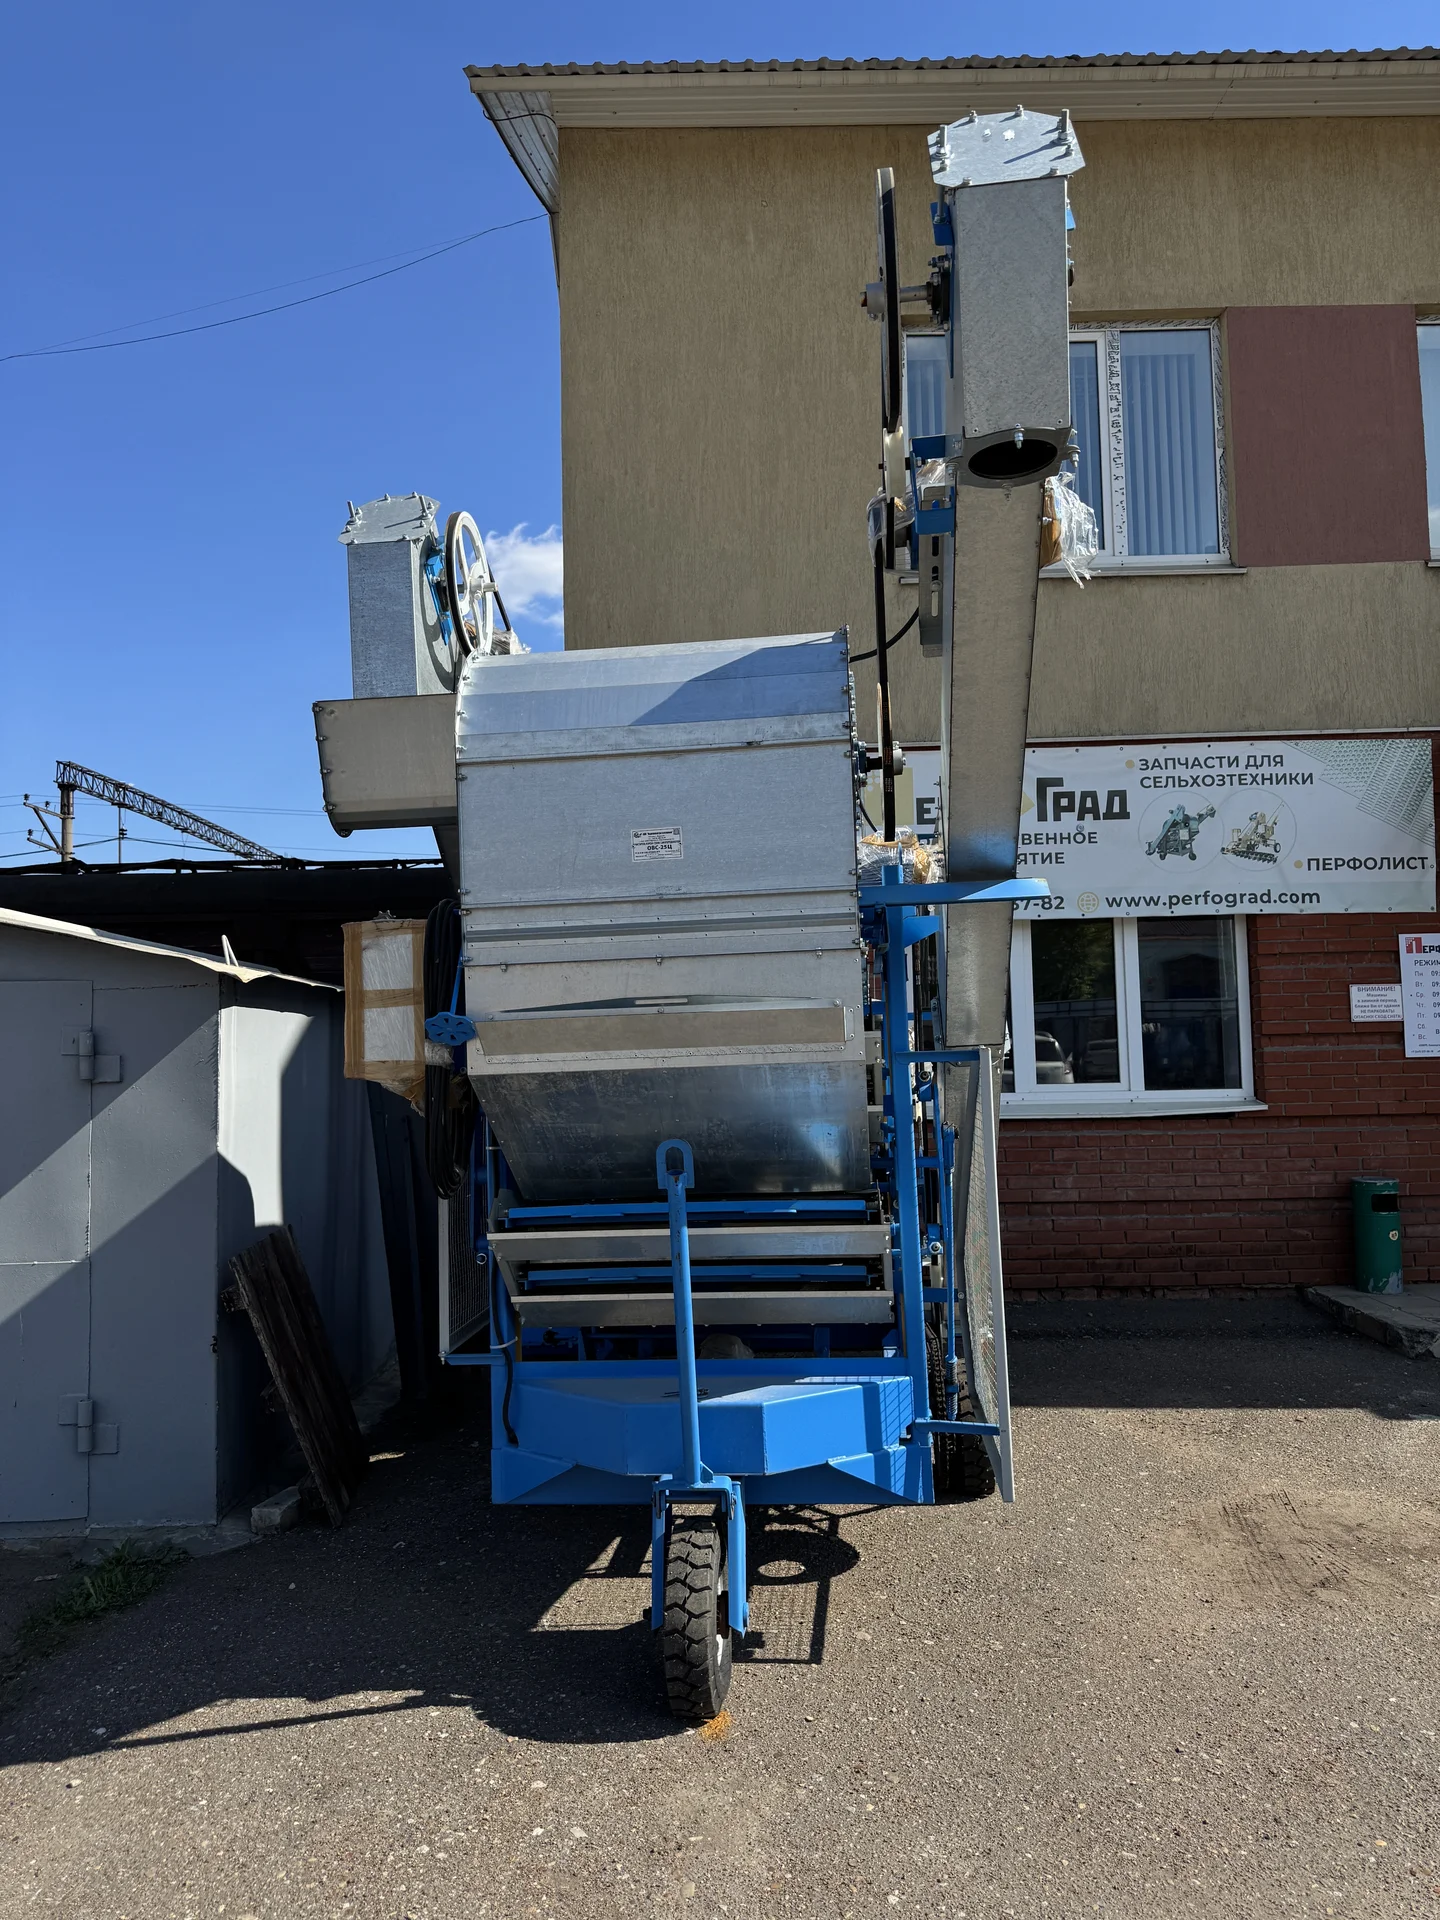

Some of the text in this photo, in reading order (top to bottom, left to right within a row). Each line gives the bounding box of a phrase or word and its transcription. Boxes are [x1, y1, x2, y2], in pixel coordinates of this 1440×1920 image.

[1138, 754, 1284, 771] ЗАПЧАСТИ ДЛЯ
[1140, 772, 1314, 789] СЕЛЬХОЗТЕХНИКИ
[1020, 832, 1098, 845] ВЕННОЕ
[1017, 852, 1065, 865] ЯТИЕ
[1307, 856, 1429, 872] ПЕРФОЛИСТ
[1105, 889, 1321, 909] www.perfograd.com
